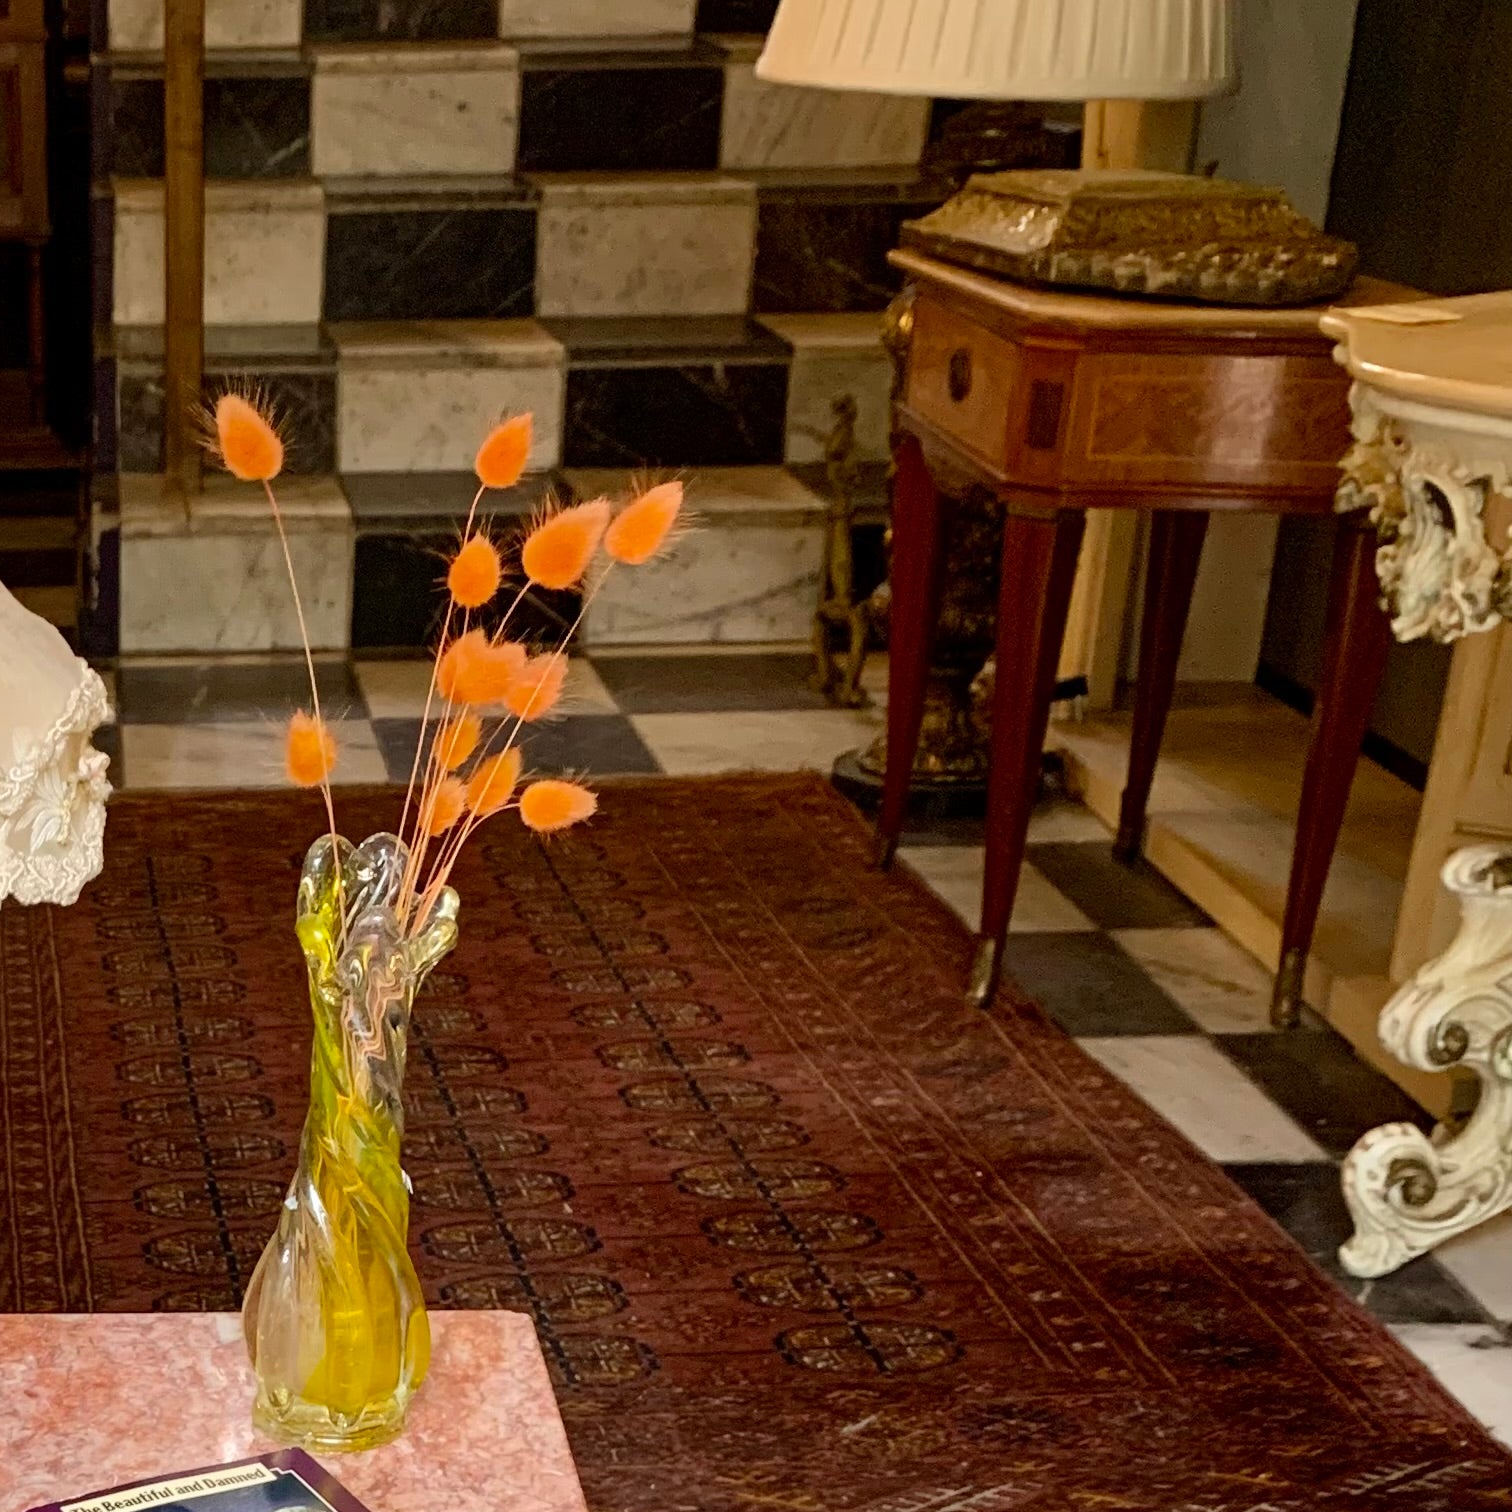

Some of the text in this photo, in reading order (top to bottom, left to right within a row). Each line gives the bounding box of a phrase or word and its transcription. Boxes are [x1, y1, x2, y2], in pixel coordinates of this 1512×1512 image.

[101, 1487, 174, 1512] Beautiful
[177, 1480, 204, 1495] and
[203, 1468, 267, 1490] Damned
